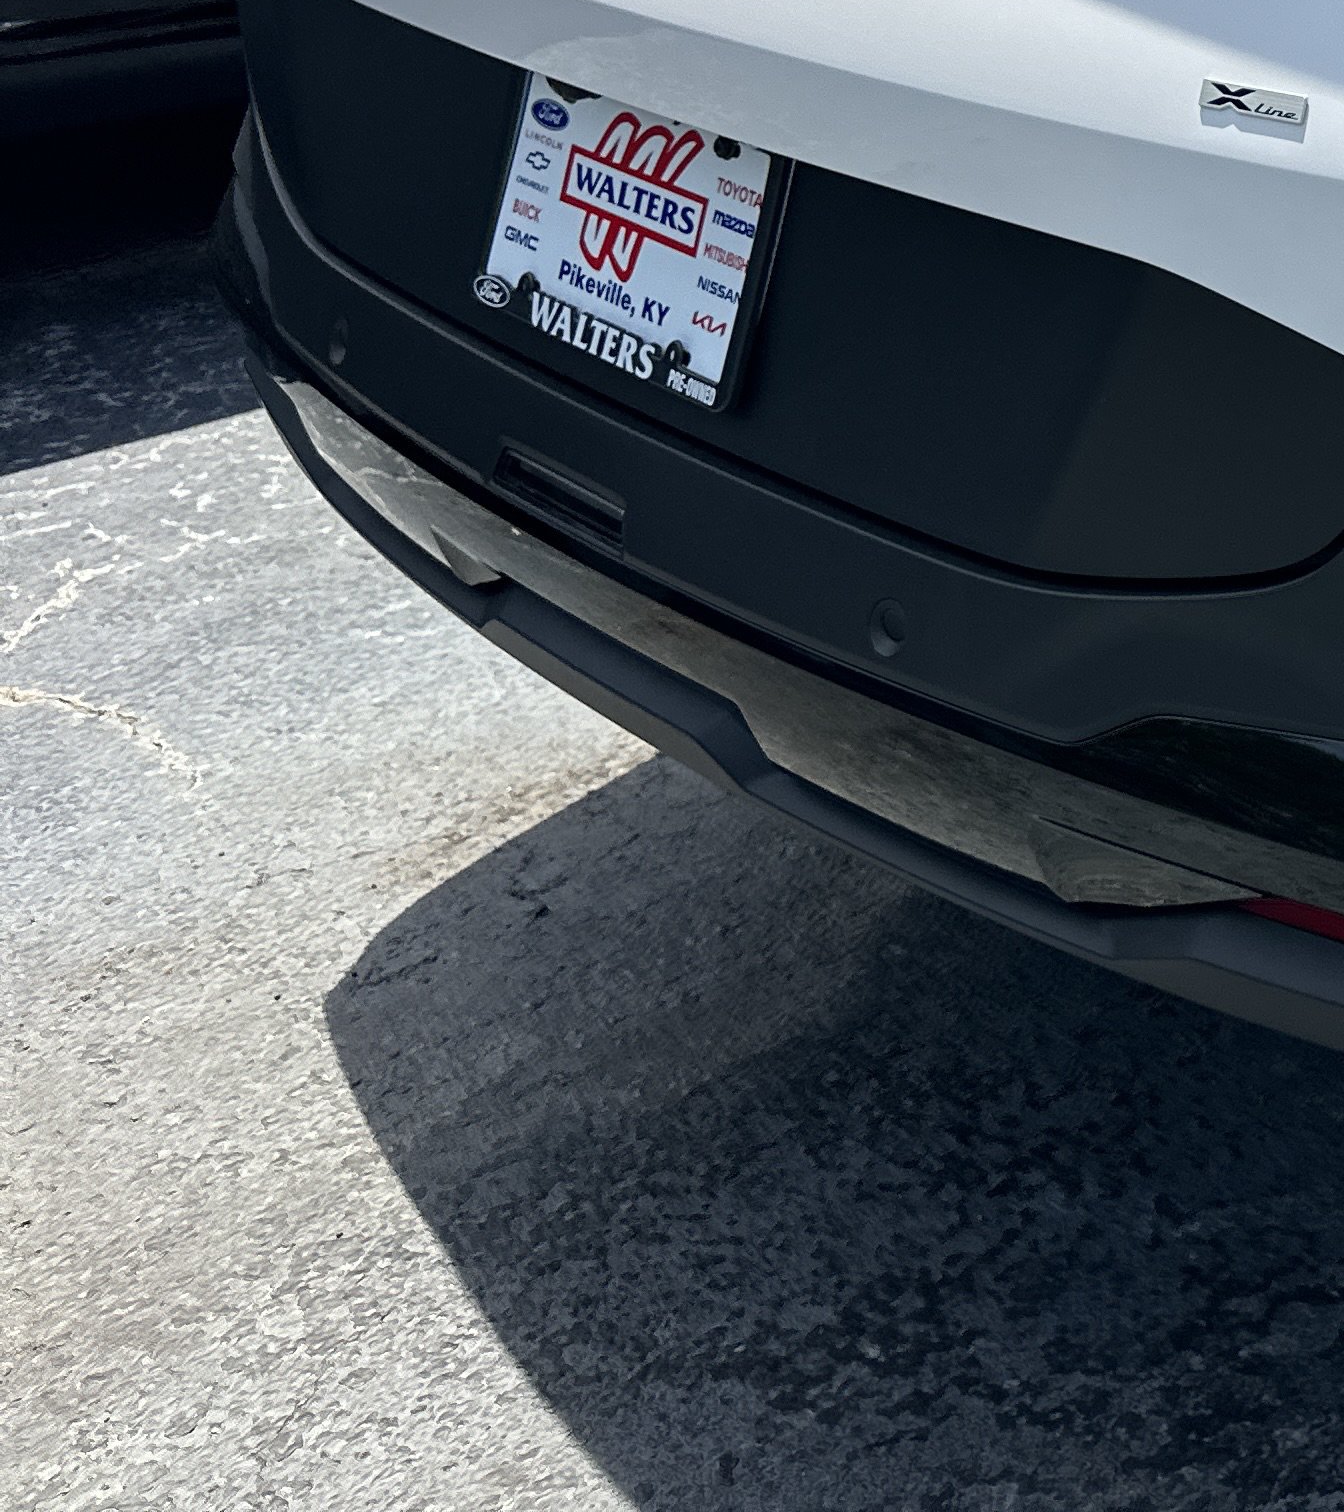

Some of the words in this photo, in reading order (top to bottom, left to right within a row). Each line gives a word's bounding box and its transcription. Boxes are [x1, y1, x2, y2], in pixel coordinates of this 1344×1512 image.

[1254, 103, 1299, 121] Line
[574, 161, 697, 237] WALTERS
[716, 177, 764, 208] TOYOTA
[504, 224, 540, 252] GMC
[557, 258, 637, 319] Pikeville,
[641, 296, 671, 327] KY
[530, 291, 656, 381] WALTERS
